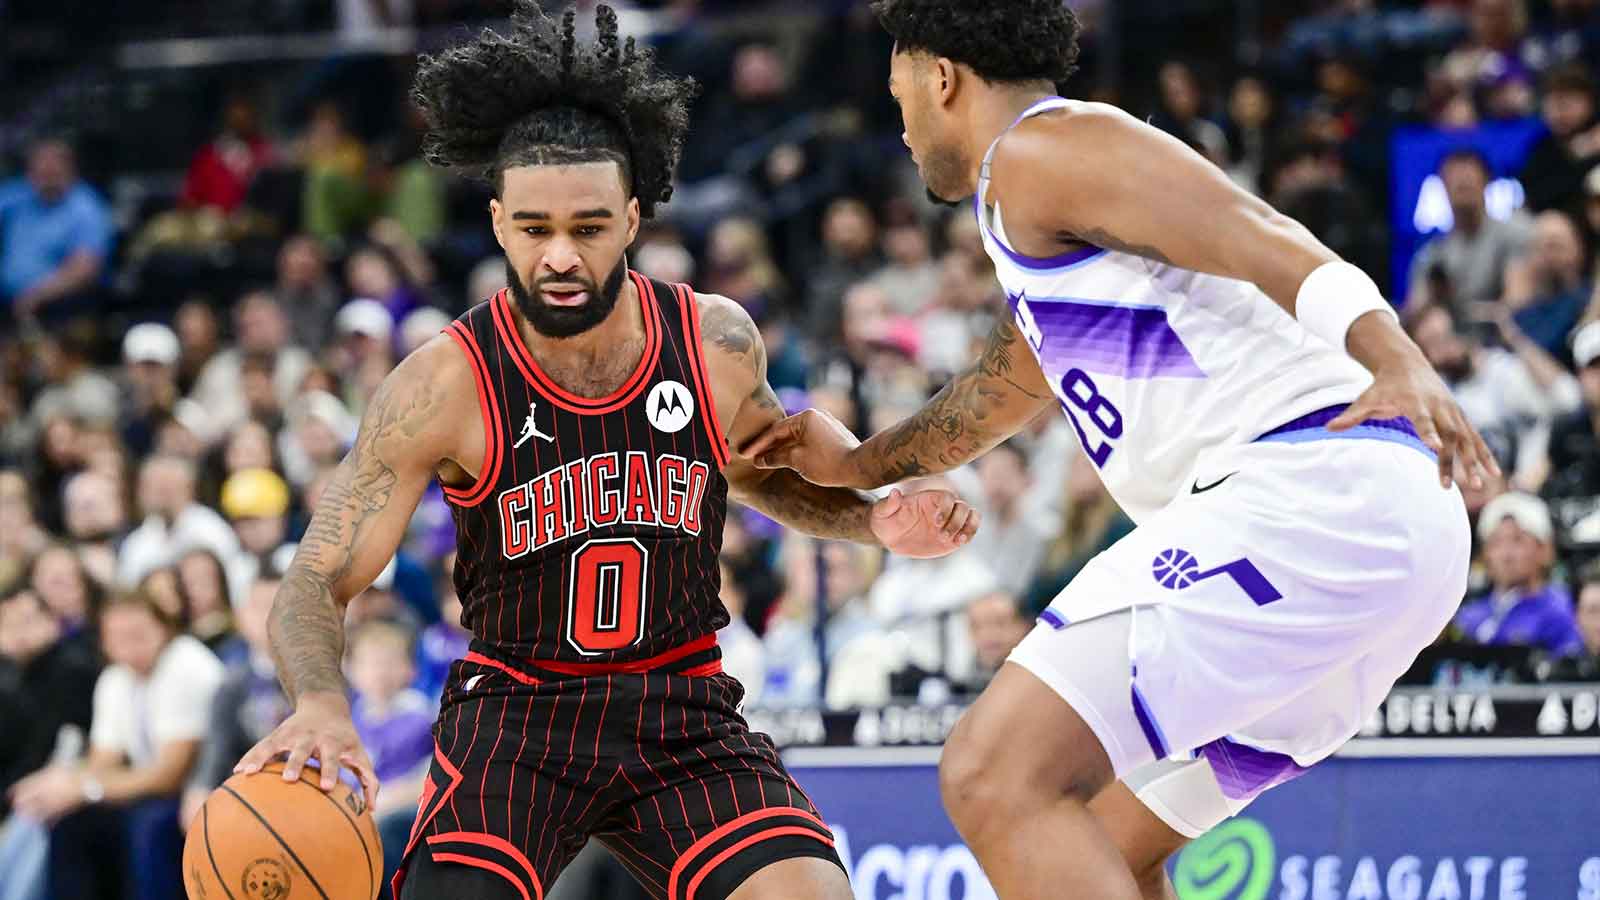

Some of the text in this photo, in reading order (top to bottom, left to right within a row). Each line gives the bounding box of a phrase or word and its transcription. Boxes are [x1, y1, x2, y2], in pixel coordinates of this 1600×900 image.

[1058, 368, 1123, 469] 28
[499, 451, 709, 560] CHICAGO
[566, 537, 649, 656] 0
[1386, 694, 1496, 734] DELTA
[1279, 855, 1528, 900] SEAGATE
